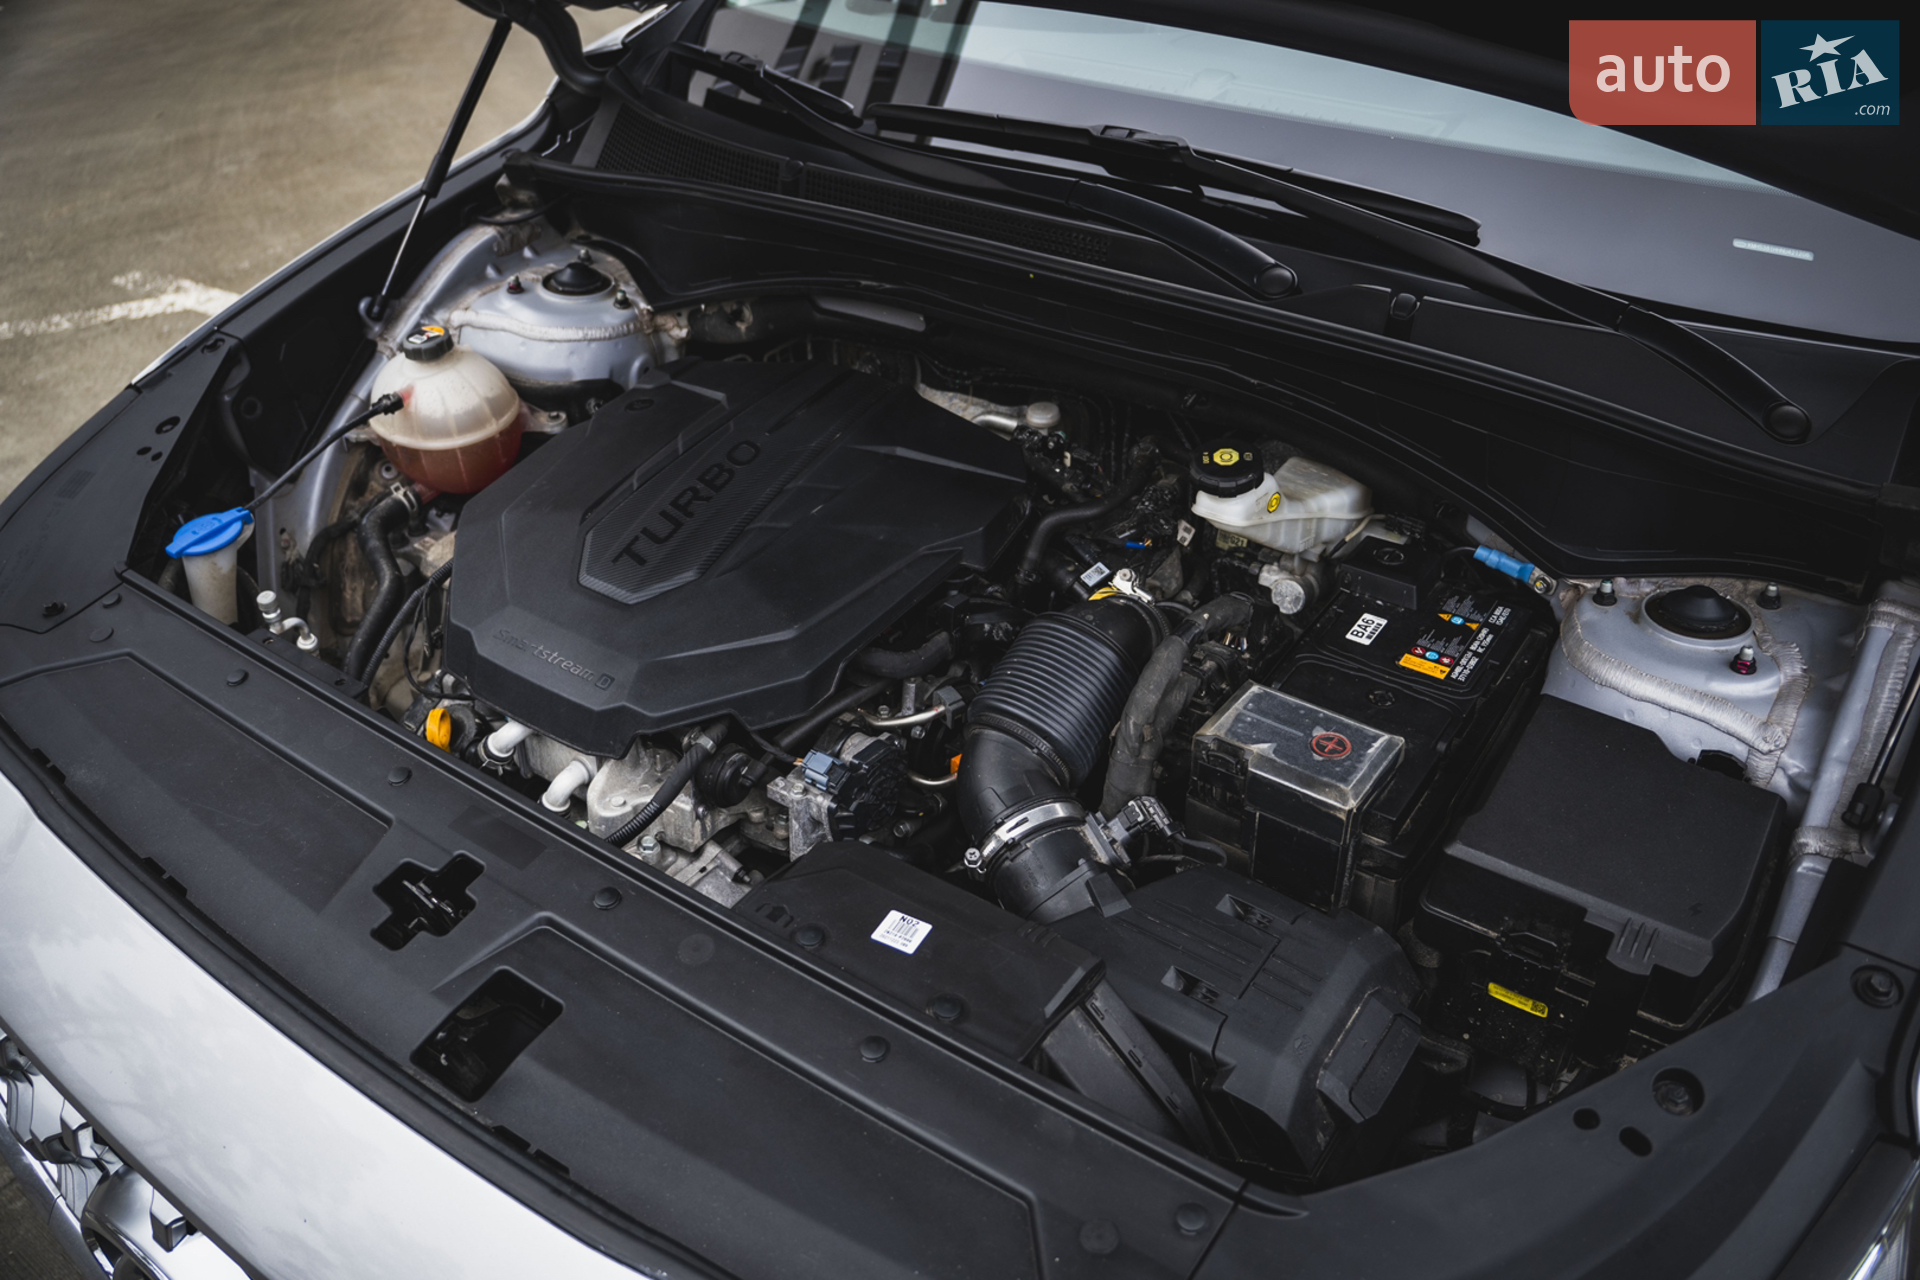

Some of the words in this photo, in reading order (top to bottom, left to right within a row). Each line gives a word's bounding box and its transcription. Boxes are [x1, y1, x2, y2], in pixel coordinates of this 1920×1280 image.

[611, 439, 761, 566] TURBO
[1350, 617, 1375, 639] BA6
[493, 629, 595, 682] Smartstream
[597, 674, 613, 689] D
